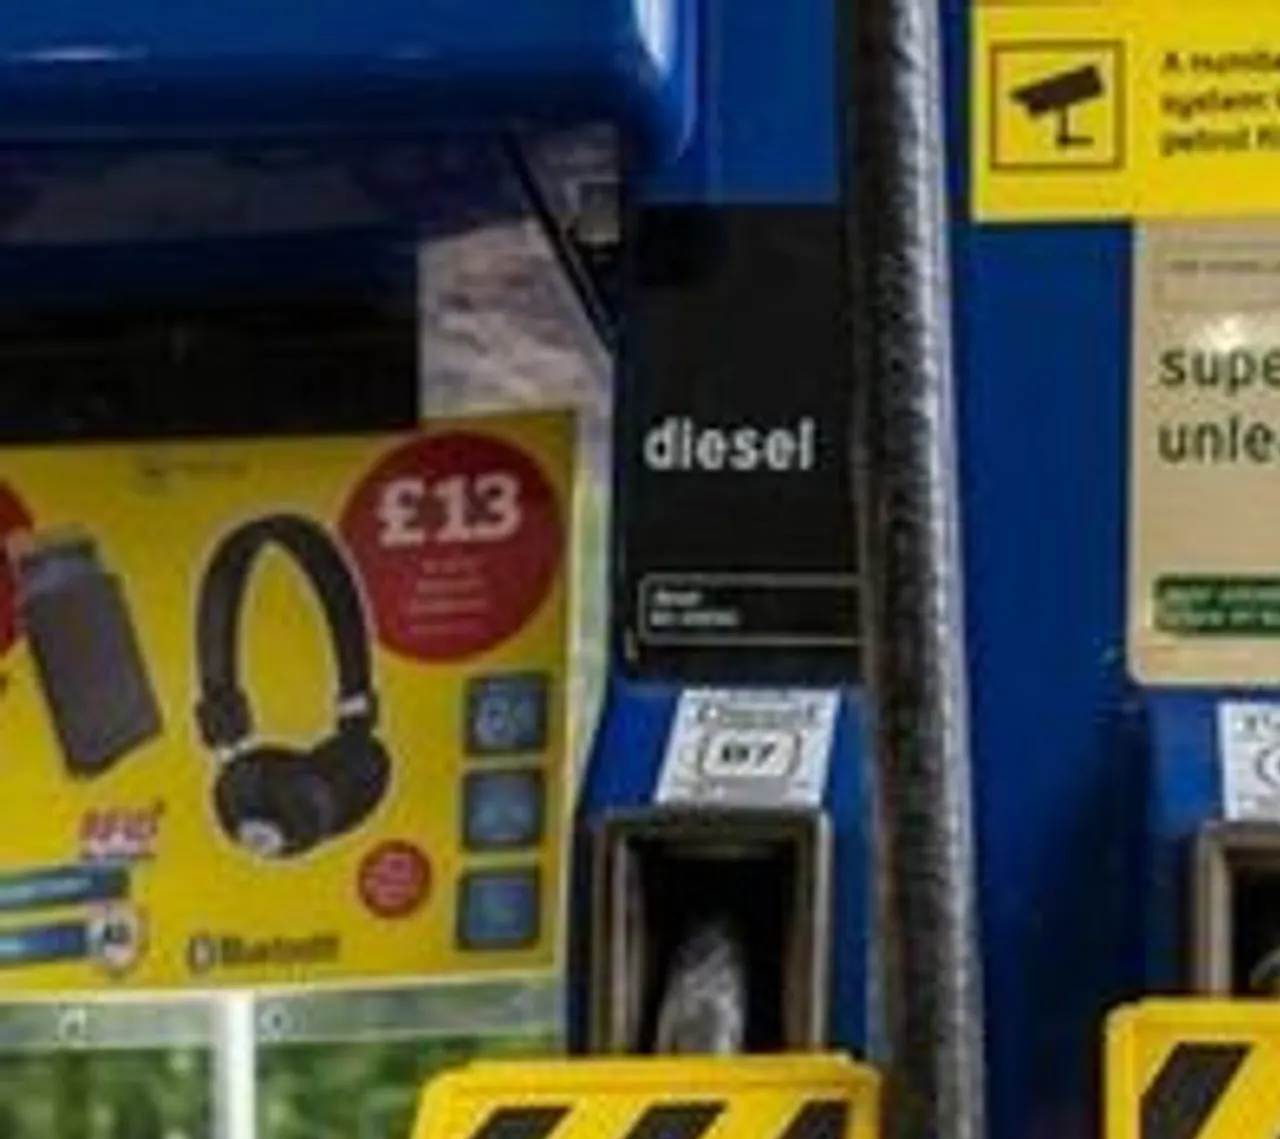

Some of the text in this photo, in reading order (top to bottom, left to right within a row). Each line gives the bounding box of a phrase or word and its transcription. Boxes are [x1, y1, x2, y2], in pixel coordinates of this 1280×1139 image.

[1164, 51, 1181, 72] A
[1162, 88, 1267, 119] system
[1161, 124, 1252, 156] petrol
[643, 417, 815, 471] diesel
[373, 471, 522, 549] £13
[720, 742, 778, 769] B7
